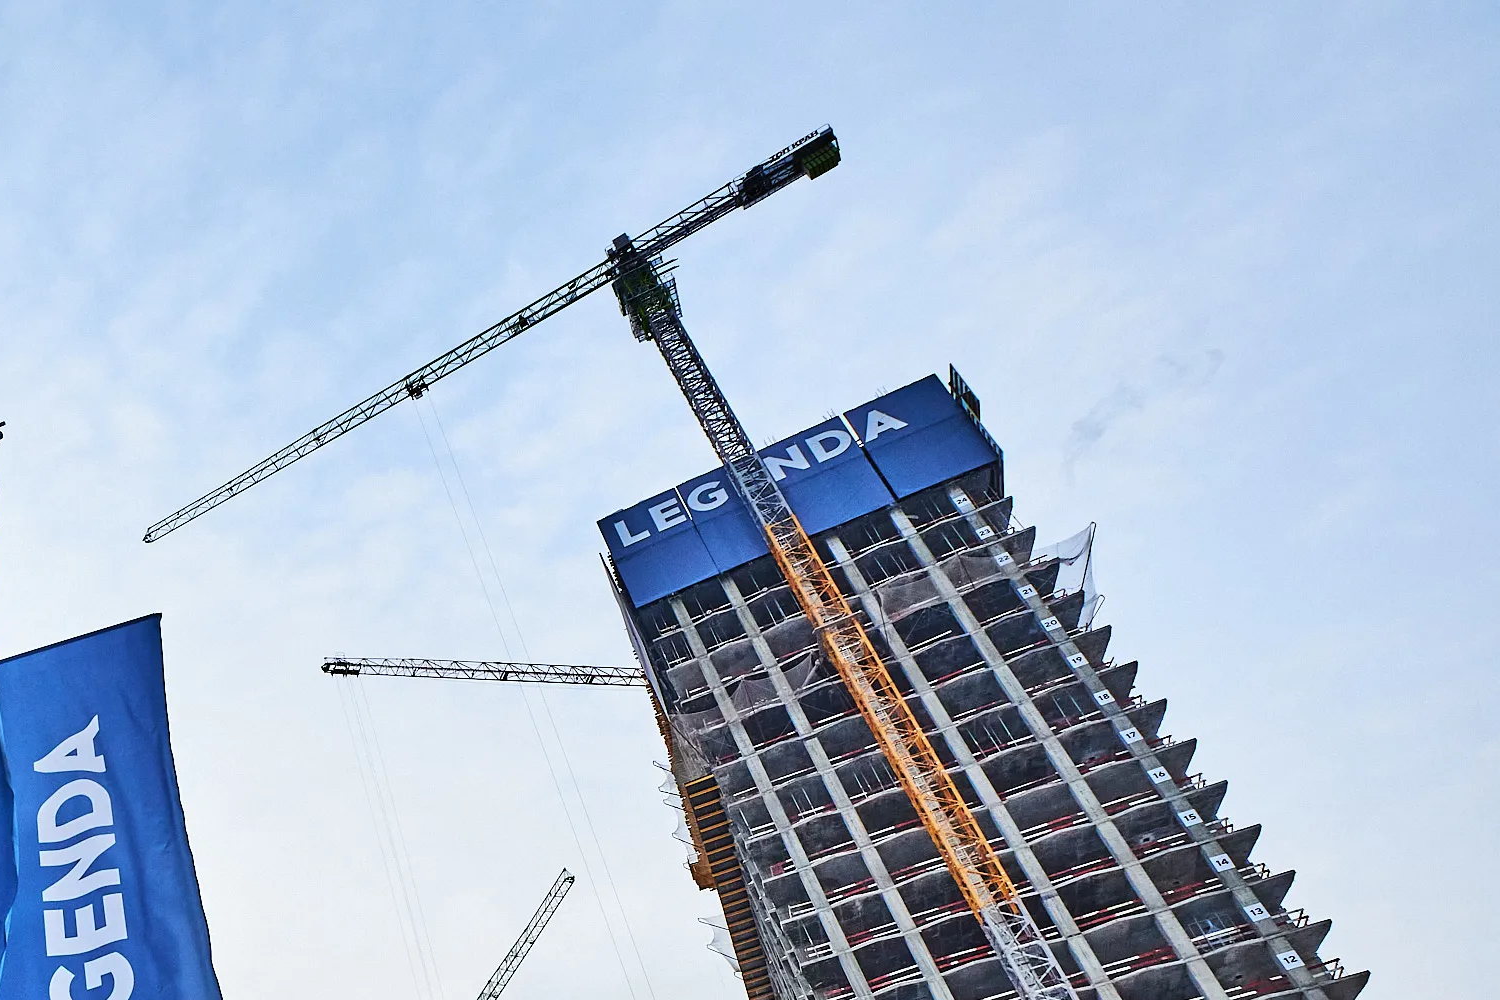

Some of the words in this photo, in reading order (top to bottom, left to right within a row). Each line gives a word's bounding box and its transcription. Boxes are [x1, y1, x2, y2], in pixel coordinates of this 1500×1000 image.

[614, 409, 908, 548] LEGNDA
[957, 497, 967, 505] 24
[979, 528, 991, 537] 23
[999, 555, 1009, 563] 22
[1022, 587, 1033, 595] 21
[1044, 620, 1058, 628] 20
[1071, 656, 1083, 664] 19
[1098, 693, 1110, 701] 18
[1125, 731, 1136, 739] 17
[1152, 771, 1166, 779] 16
[1183, 813, 1196, 822] 15
[1215, 858, 1229, 867] 14
[1249, 907, 1264, 916] 13
[1283, 955, 1298, 964] 12
